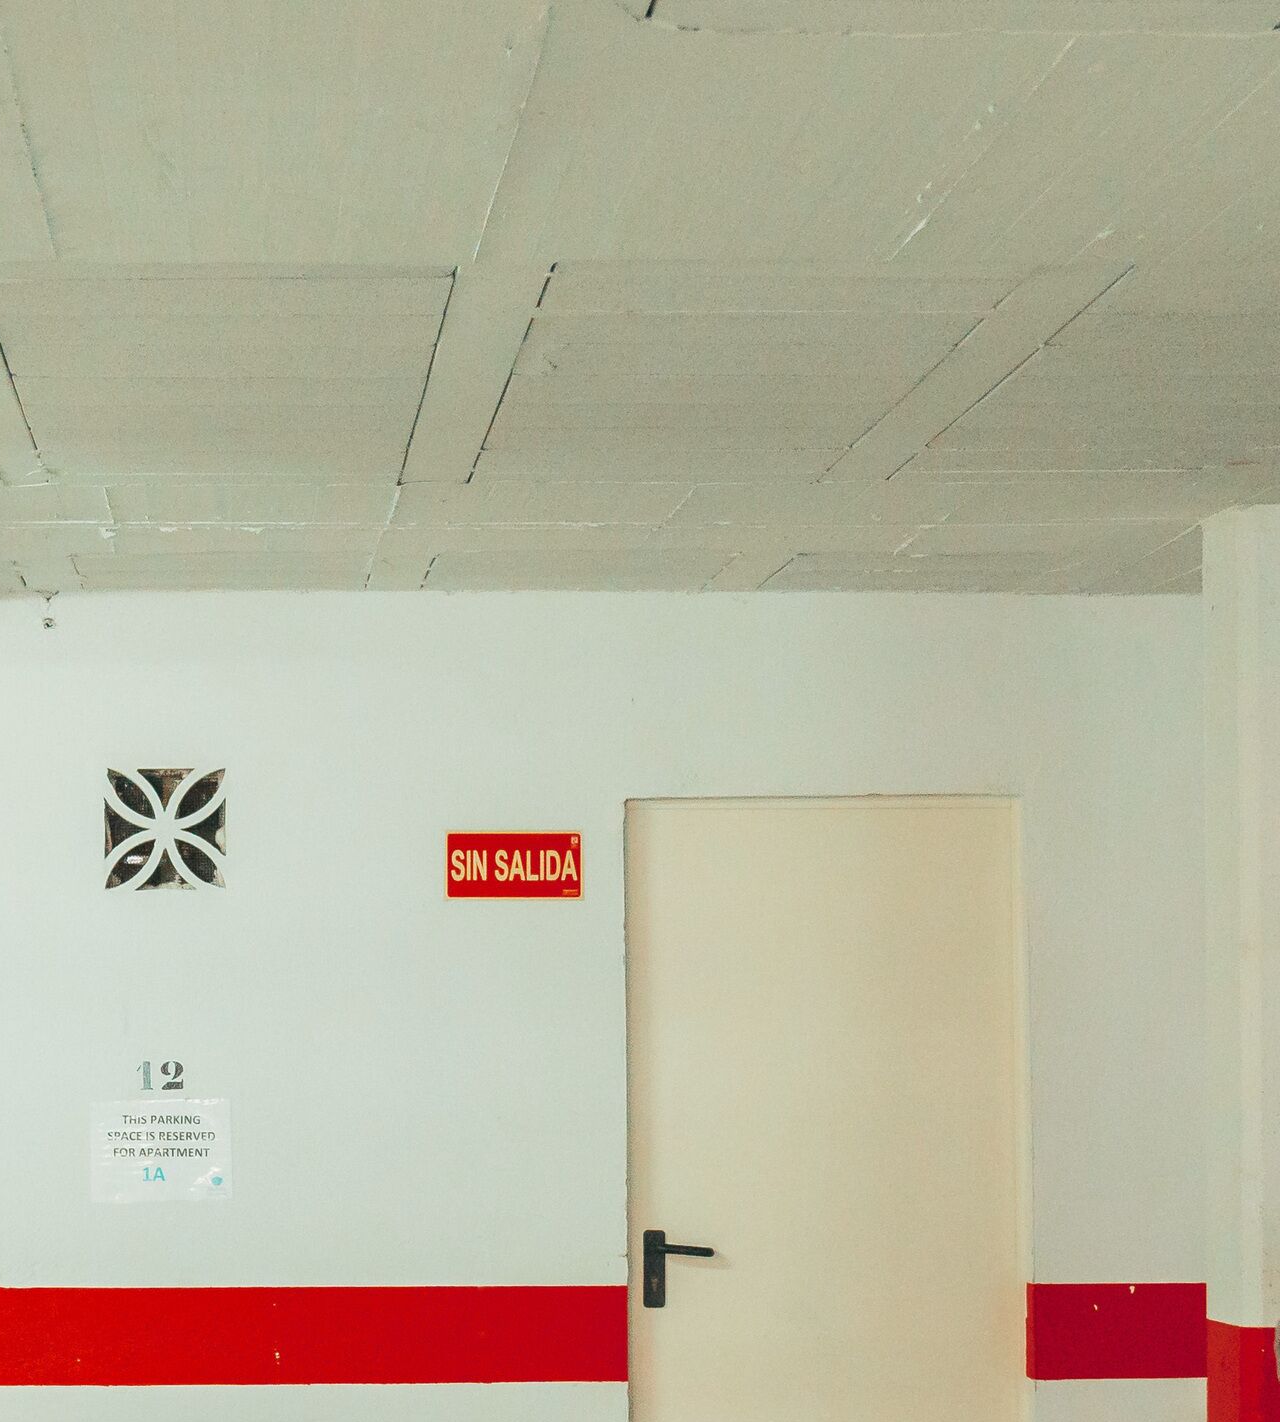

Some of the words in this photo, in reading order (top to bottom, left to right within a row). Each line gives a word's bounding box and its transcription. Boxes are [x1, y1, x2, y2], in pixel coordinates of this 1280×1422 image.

[451, 849, 487, 881] SIN
[495, 849, 578, 881] SALIDA
[136, 1060, 184, 1090] 12
[122, 1114, 147, 1125] THIS
[150, 1114, 201, 1125] PARKING
[107, 1131, 142, 1141] SPACE
[146, 1131, 156, 1141] IS
[159, 1131, 216, 1141] RESERVED
[113, 1147, 136, 1158] FOR
[138, 1147, 210, 1158] APARTMENT
[142, 1166, 166, 1182] 1A
